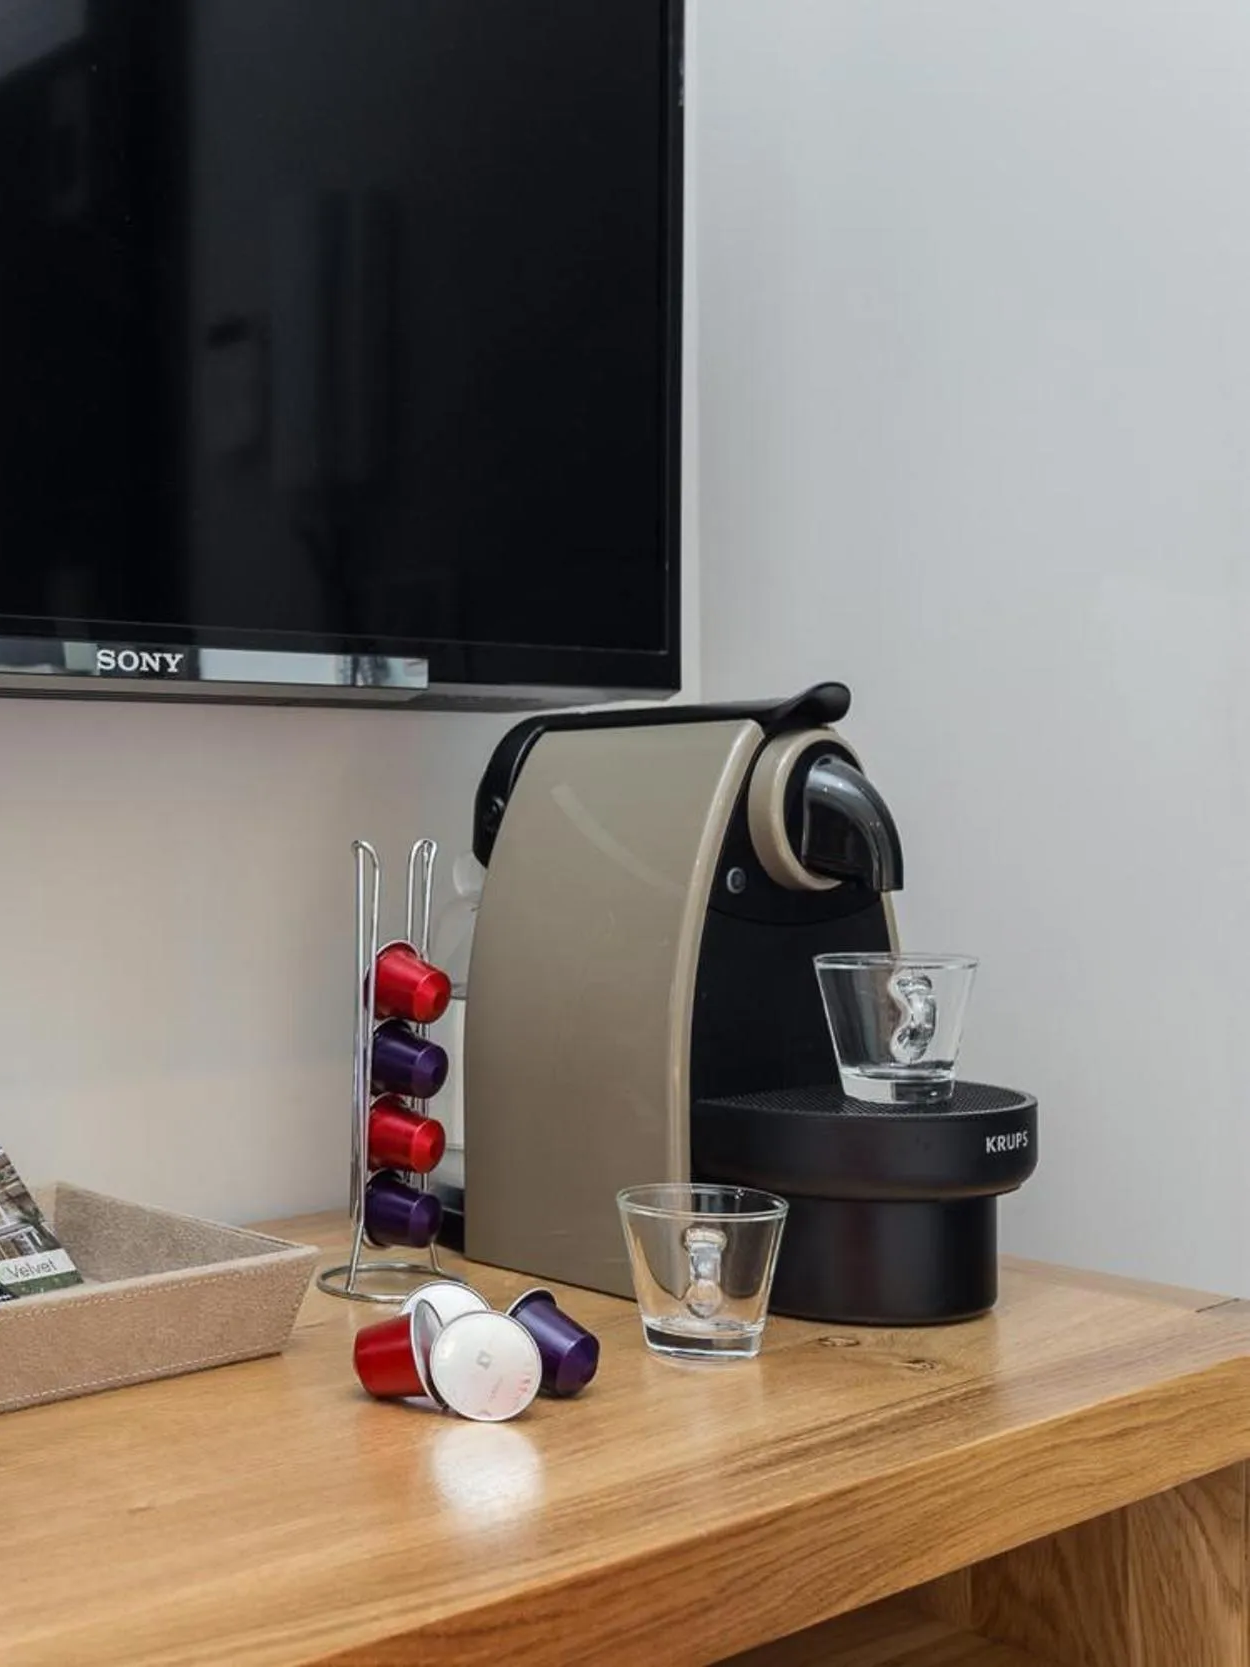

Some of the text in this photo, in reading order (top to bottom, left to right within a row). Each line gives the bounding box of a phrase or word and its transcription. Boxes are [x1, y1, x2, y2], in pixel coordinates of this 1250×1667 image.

[96, 649, 184, 673] SONY
[986, 1130, 1028, 1153] KRUPS
[6, 1258, 57, 1278] Velvet
